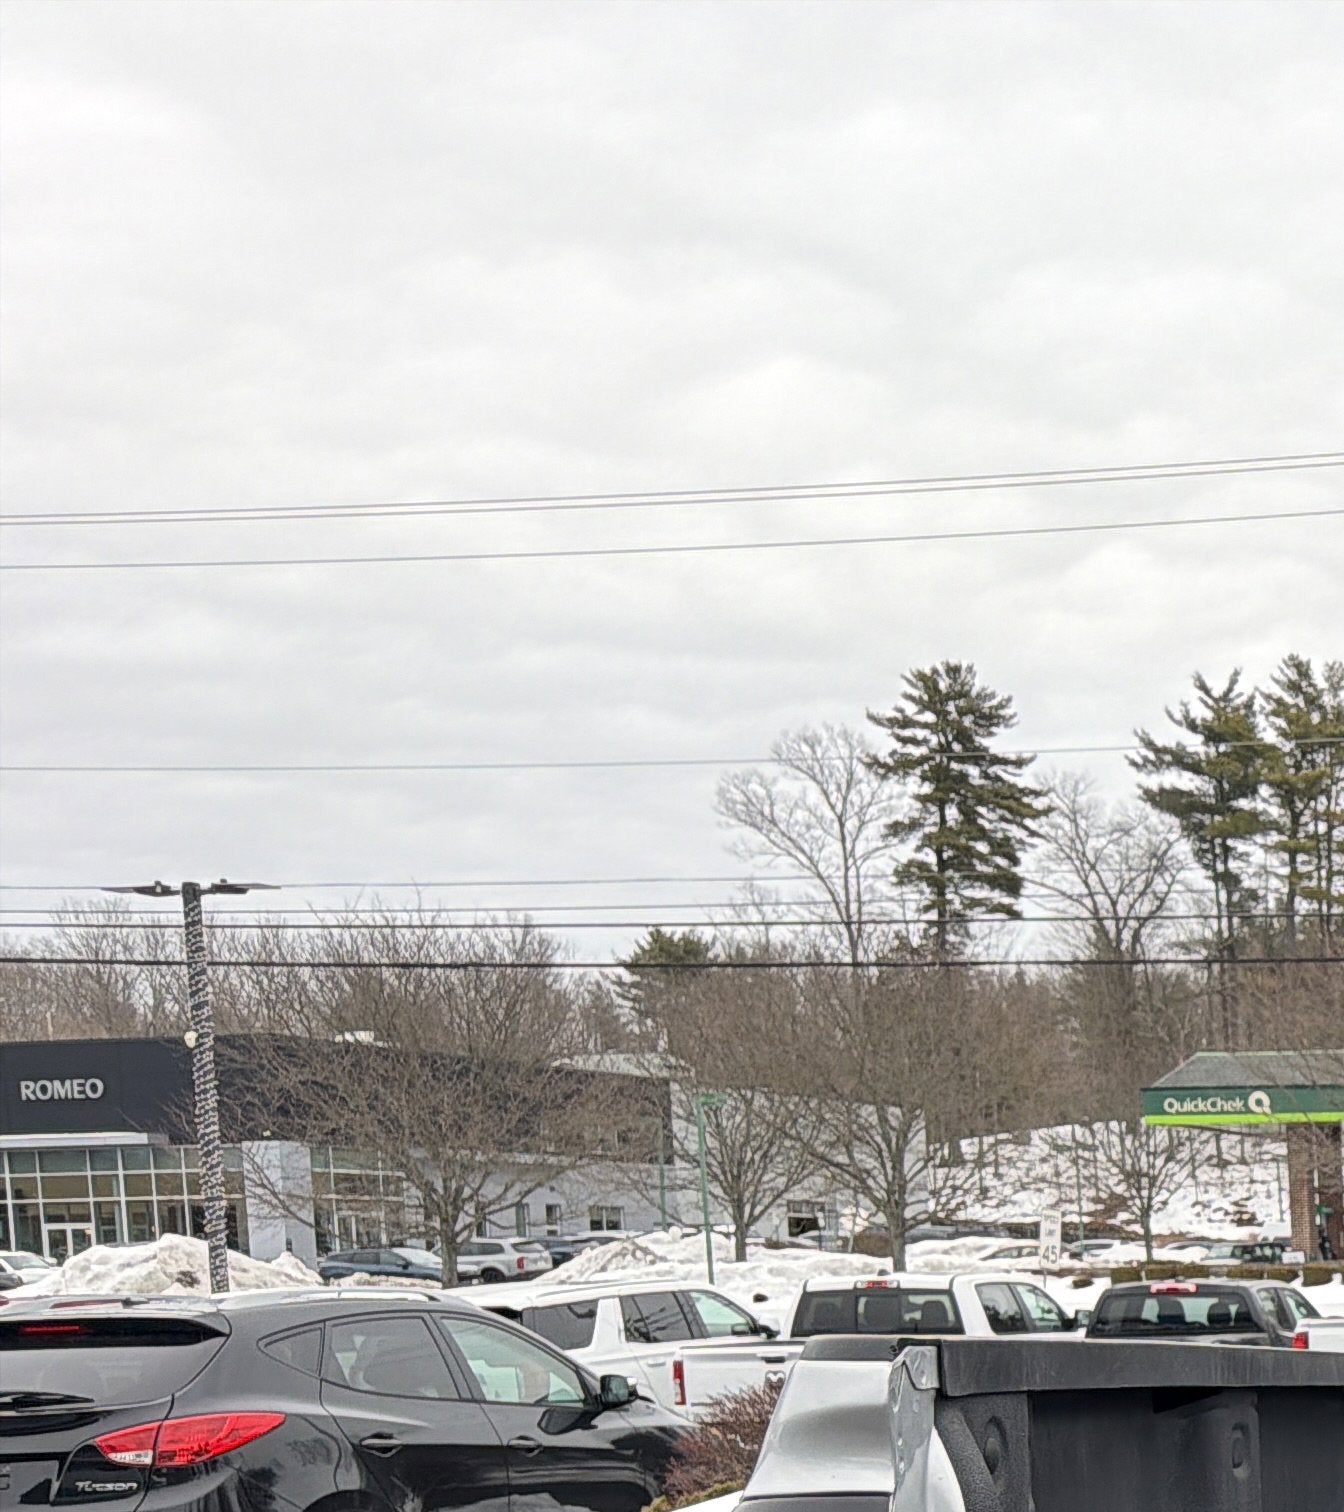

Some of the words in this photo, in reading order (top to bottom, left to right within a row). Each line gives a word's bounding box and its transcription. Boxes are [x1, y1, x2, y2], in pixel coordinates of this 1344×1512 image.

[20, 1078, 104, 1100] ROMEO
[1163, 1096, 1246, 1114] QuickChek
[1042, 1245, 1057, 1264] 45
